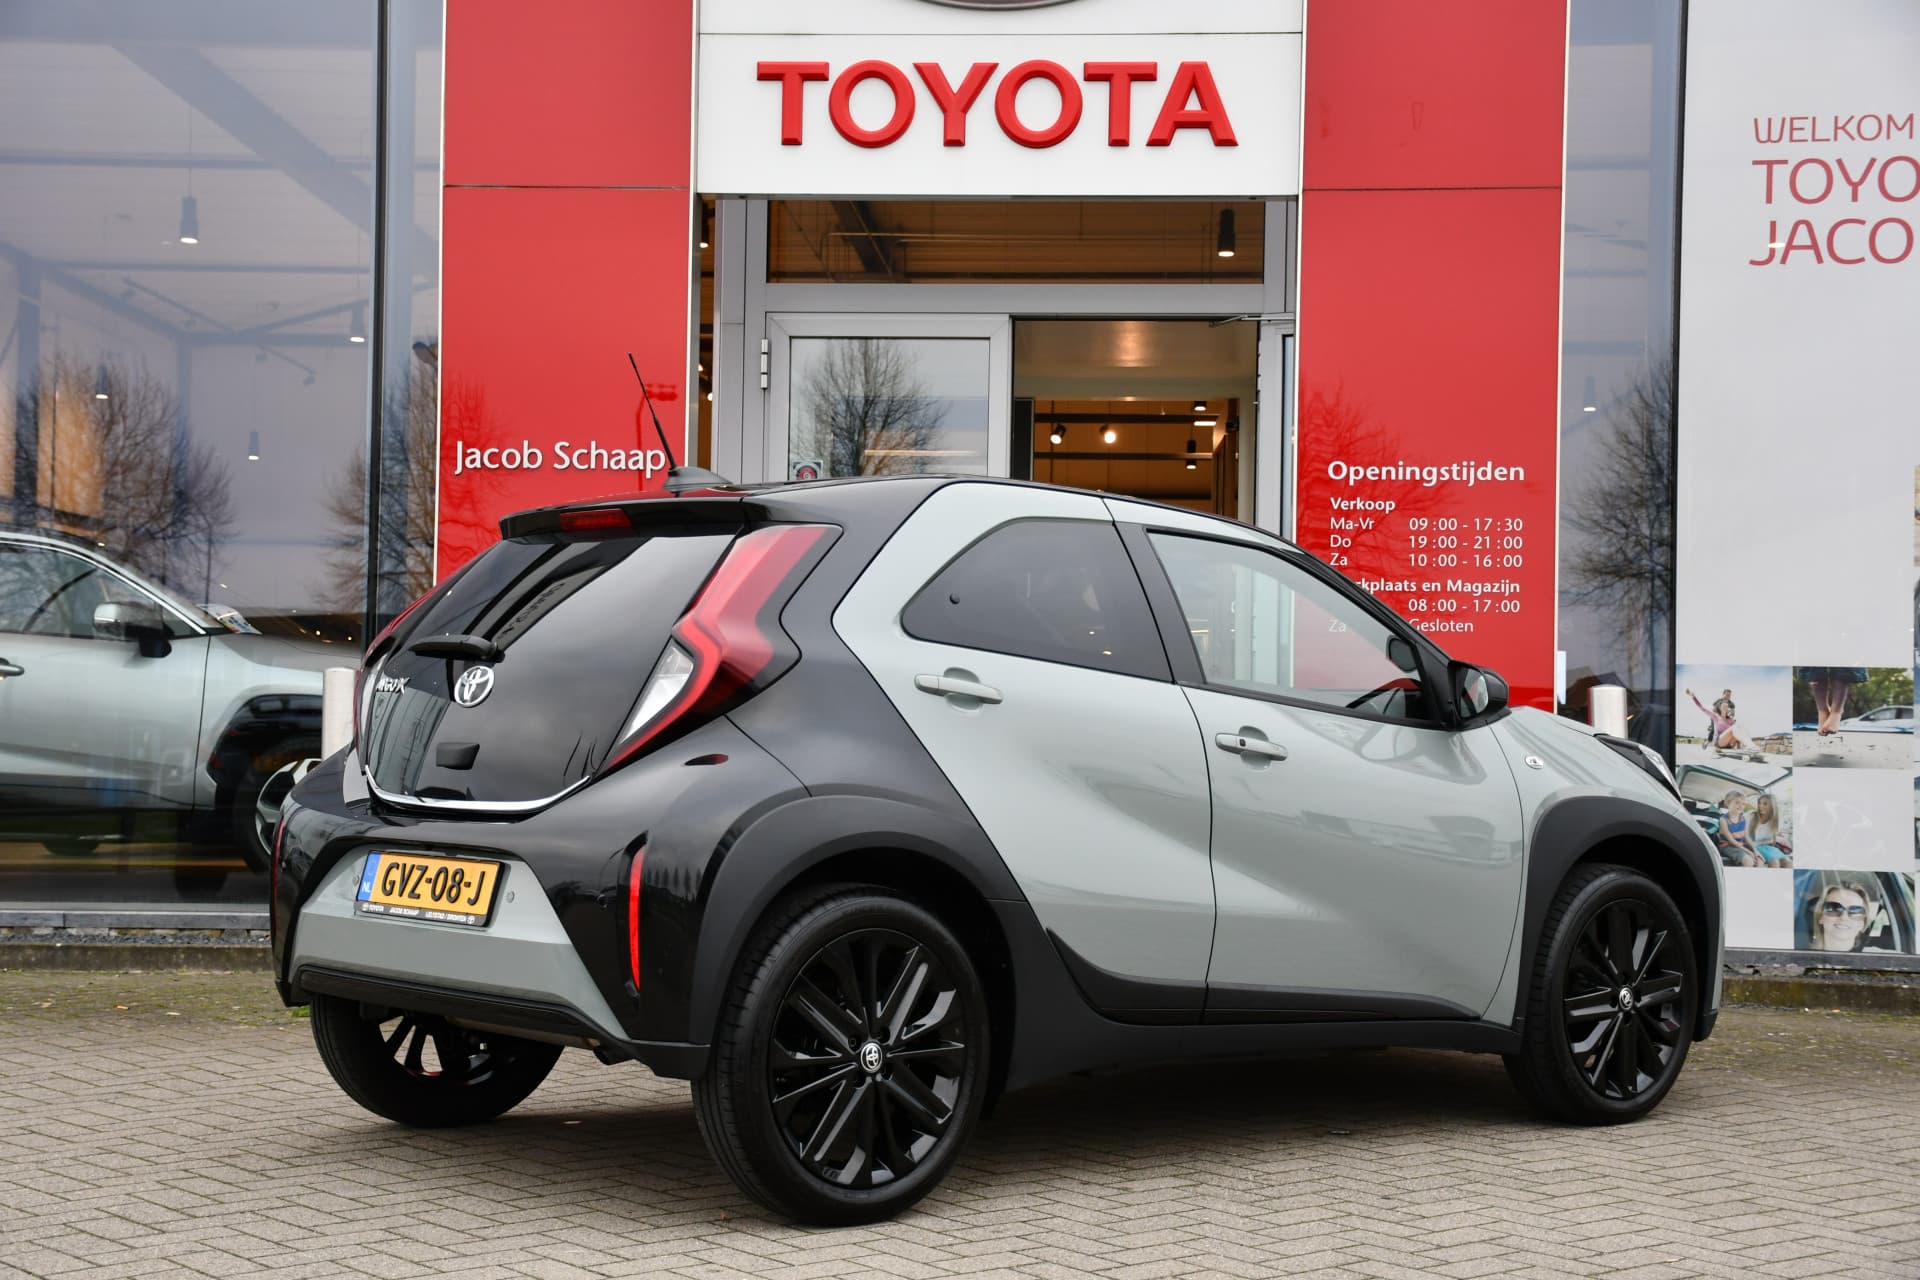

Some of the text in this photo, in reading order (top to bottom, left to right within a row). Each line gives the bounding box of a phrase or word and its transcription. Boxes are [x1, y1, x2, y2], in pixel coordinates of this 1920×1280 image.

[756, 59, 1239, 149] TOYOTA
[1753, 113, 1914, 143] WELKOM
[1752, 156, 1920, 204] TOYO
[1749, 217, 1914, 266] JACO
[454, 440, 666, 479] Jacob Schaap
[1327, 460, 1525, 487] Openingstijden
[1330, 497, 1396, 514] Verkoop
[1330, 517, 1375, 530] Ma-Vr
[1330, 534, 1352, 548] Do
[1329, 553, 1348, 566] Za
[1355, 577, 1520, 597] kplaats en Magazijn
[381, 862, 486, 906] GVZ-08-J
